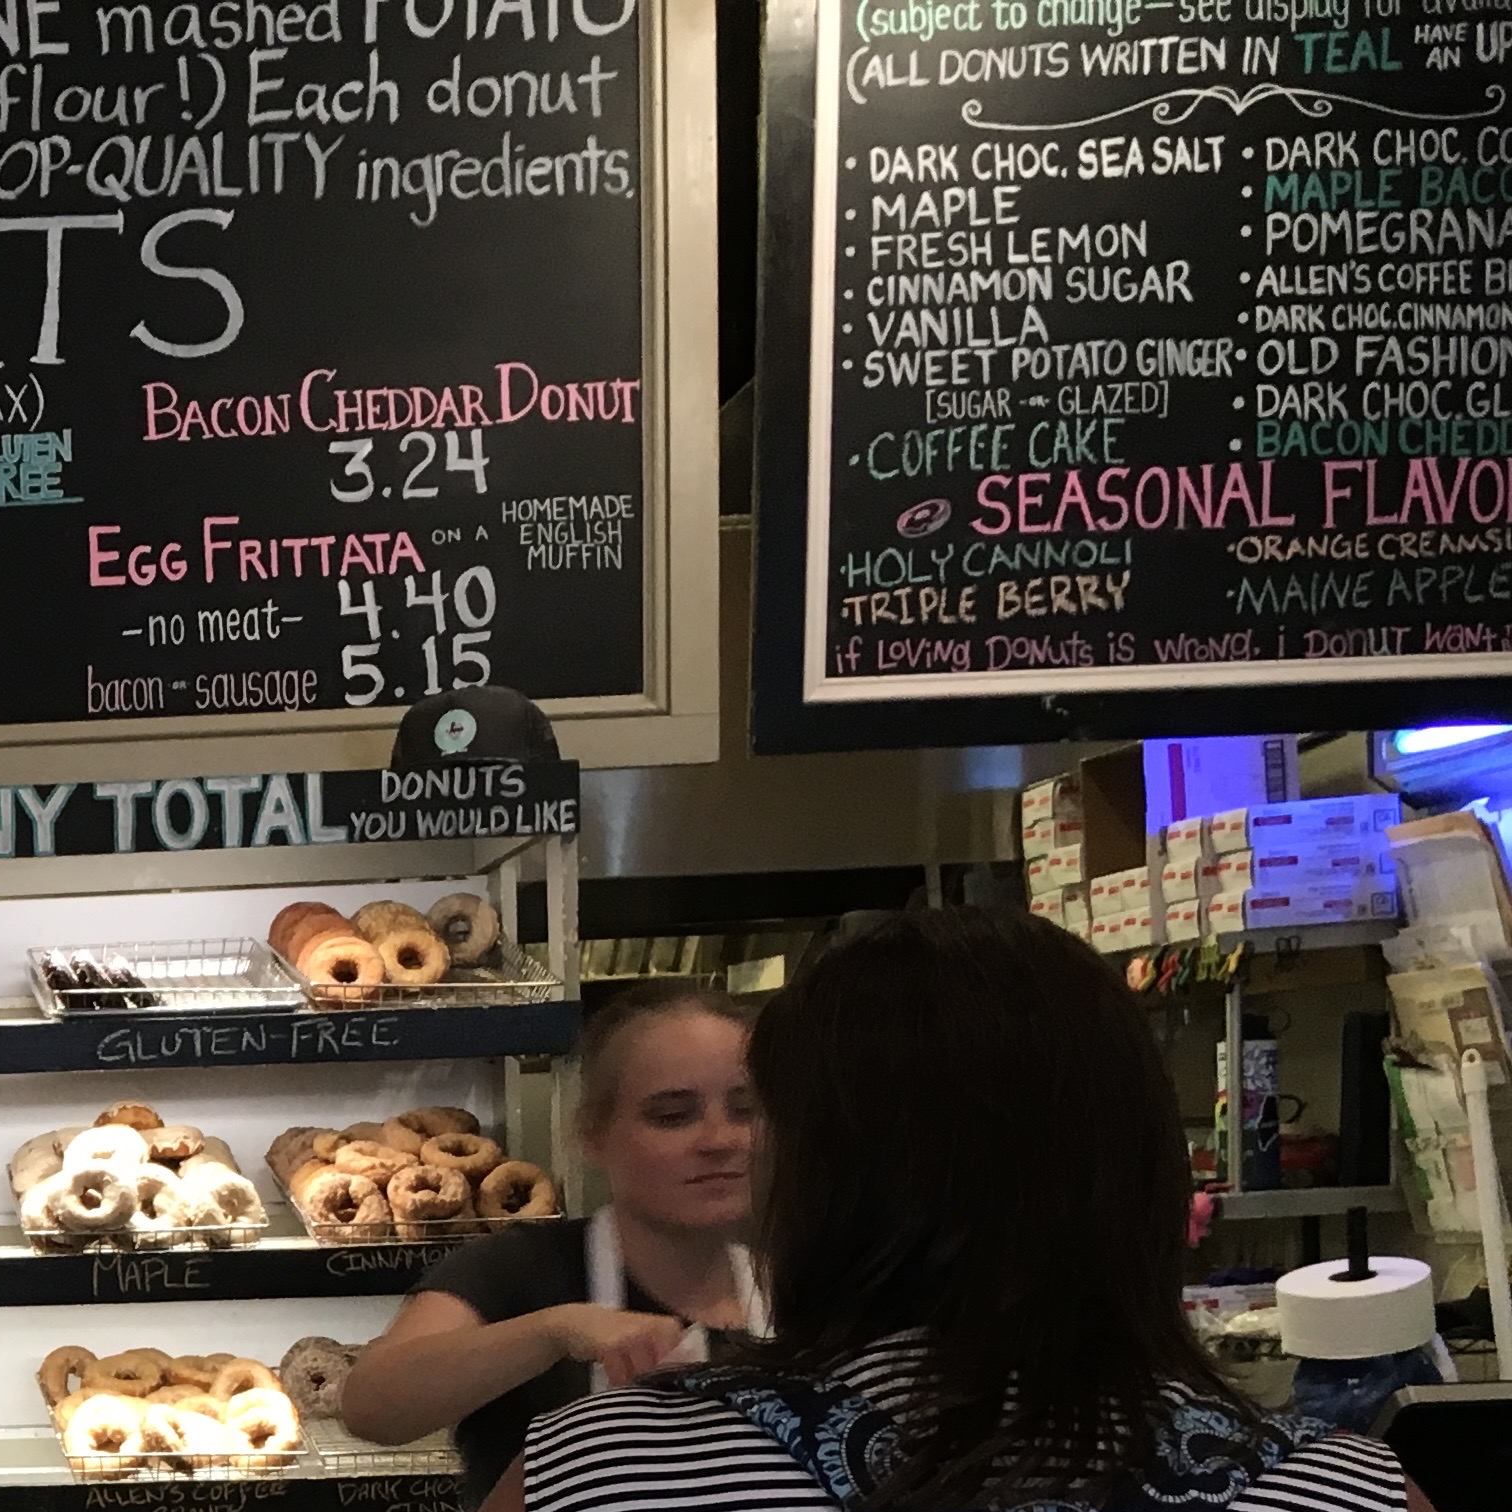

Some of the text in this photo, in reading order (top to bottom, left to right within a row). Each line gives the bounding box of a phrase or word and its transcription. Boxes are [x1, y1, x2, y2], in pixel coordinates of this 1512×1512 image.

[96, 0, 342, 54] mashed
[363, 0, 638, 42] POTATO
[992, 0, 1027, 30] to
[846, 22, 1470, 105] (ALL DONUTS WRITTEN IN TEAL HAVE AN
[246, 51, 402, 127] Each
[426, 57, 618, 121] donut
[869, 136, 1225, 184] DARK CHOC. SEA SALT
[1265, 127, 1469, 172] DARK CHOC.
[355, 142, 637, 227] ingredients.
[1264, 168, 1403, 213] MAPLE
[871, 185, 1023, 232] MAPLE
[871, 219, 1149, 271] FRESH LEMON
[866, 259, 1194, 306] CINNAMON SUGAR
[1255, 258, 1473, 299] ALLEN'S COFFEE
[866, 304, 1050, 349] VANILLA
[1255, 303, 1326, 334] DARK
[863, 336, 1234, 389] SWEET POTATO GINGER
[1256, 336, 1340, 376] OLD
[142, 362, 641, 443] BACON CHEDDAR DONUT
[1255, 380, 1464, 422] DARK CHOC.
[867, 417, 1128, 481] COFFEE CAKE
[1256, 417, 1389, 459] BACON
[327, 427, 492, 503] 3.24
[500, 494, 635, 525] HOMEMADE
[969, 458, 1296, 536] SEASONAL
[430, 525, 490, 545] ON A
[518, 520, 624, 546] ENGLISH
[1235, 532, 1372, 565] ORANGE
[526, 544, 624, 571] MUFFIN
[847, 537, 1134, 589] HOLY CANNOLI
[337, 565, 498, 641] 4.40
[843, 568, 1132, 627] TRIPLE BERRY
[1235, 561, 1512, 617] MAINE APPLE
[87, 631, 492, 714] bacon sausage 5.15
[835, 635, 864, 675] if
[380, 762, 528, 803] DONUTS
[92, 771, 352, 855] TOTAL
[350, 799, 579, 844] YOU WOULD LIKE
[91, 1253, 213, 1297] MAPLE
[338, 1479, 400, 1504] DARK
